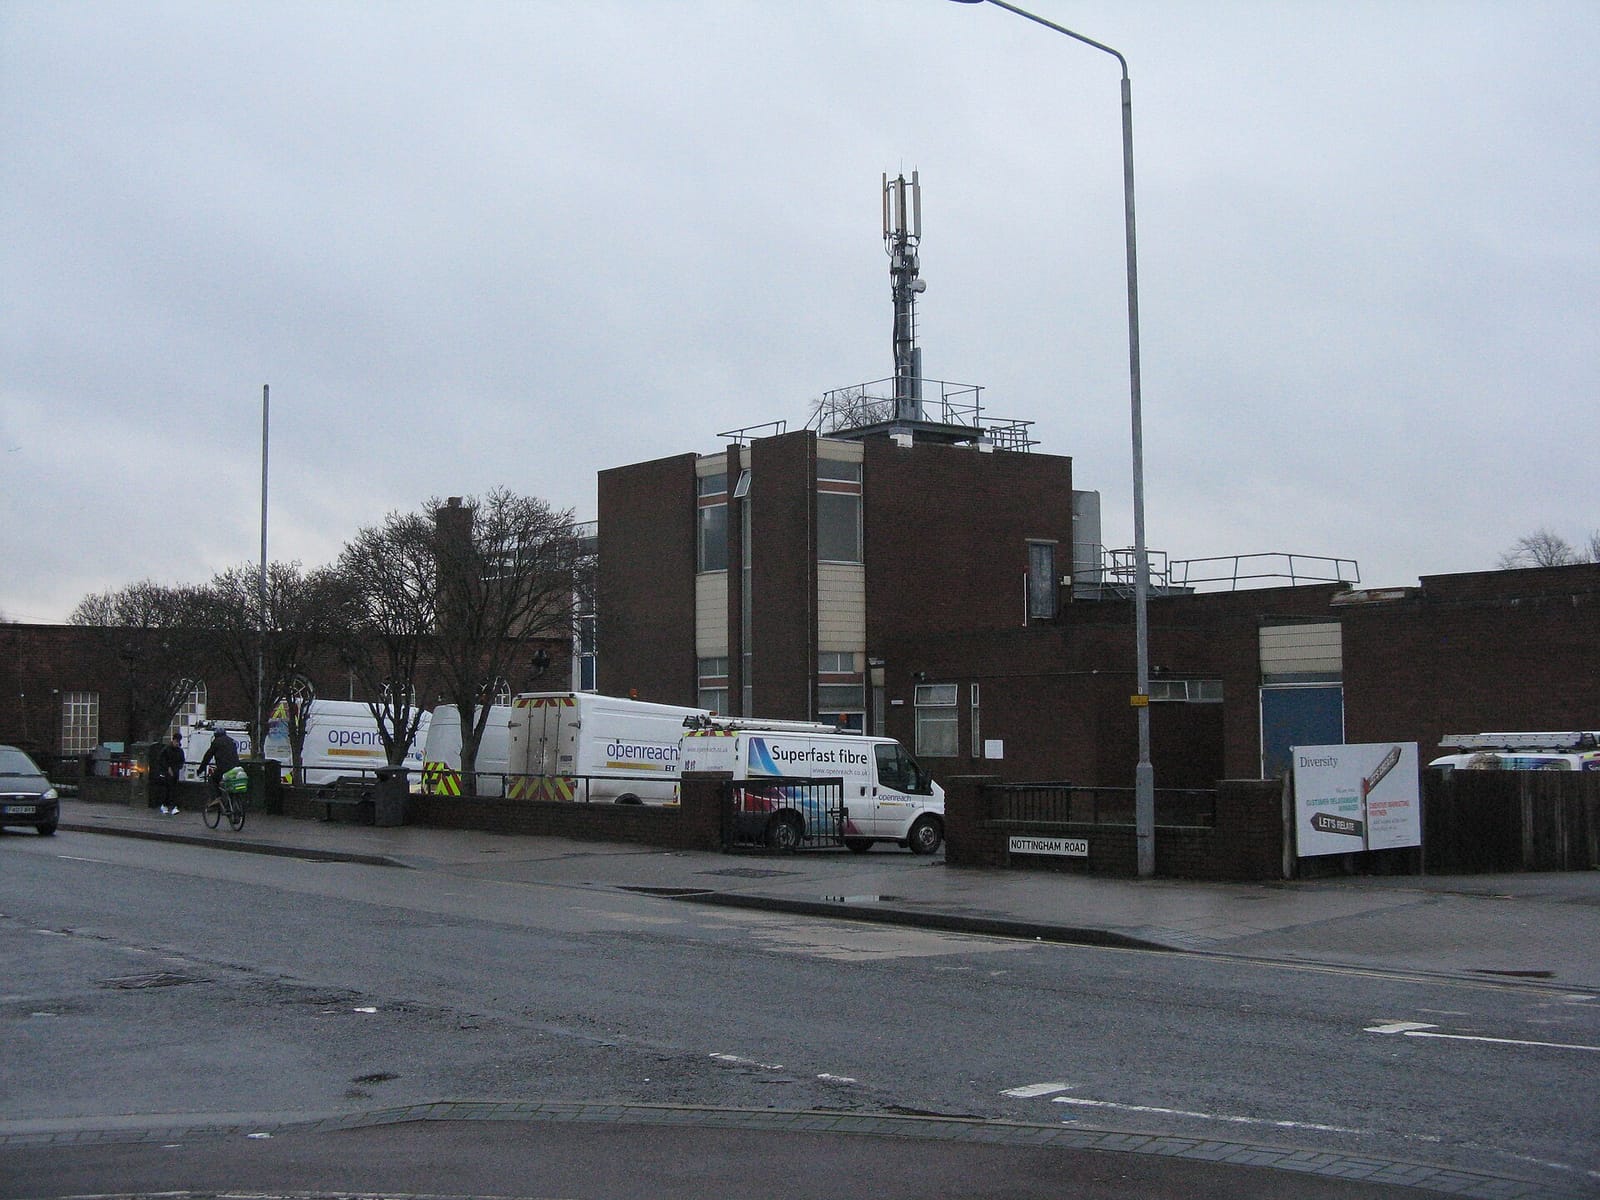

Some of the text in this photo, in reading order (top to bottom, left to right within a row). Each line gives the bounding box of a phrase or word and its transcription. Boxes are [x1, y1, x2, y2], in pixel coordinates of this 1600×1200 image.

[606, 743, 678, 760] openreach
[772, 745, 868, 765] Superfast fibre
[665, 764, 676, 772] BT
[1299, 755, 1338, 769] Diversity
[1011, 839, 1086, 853] NOTTINGHAM ROAD
